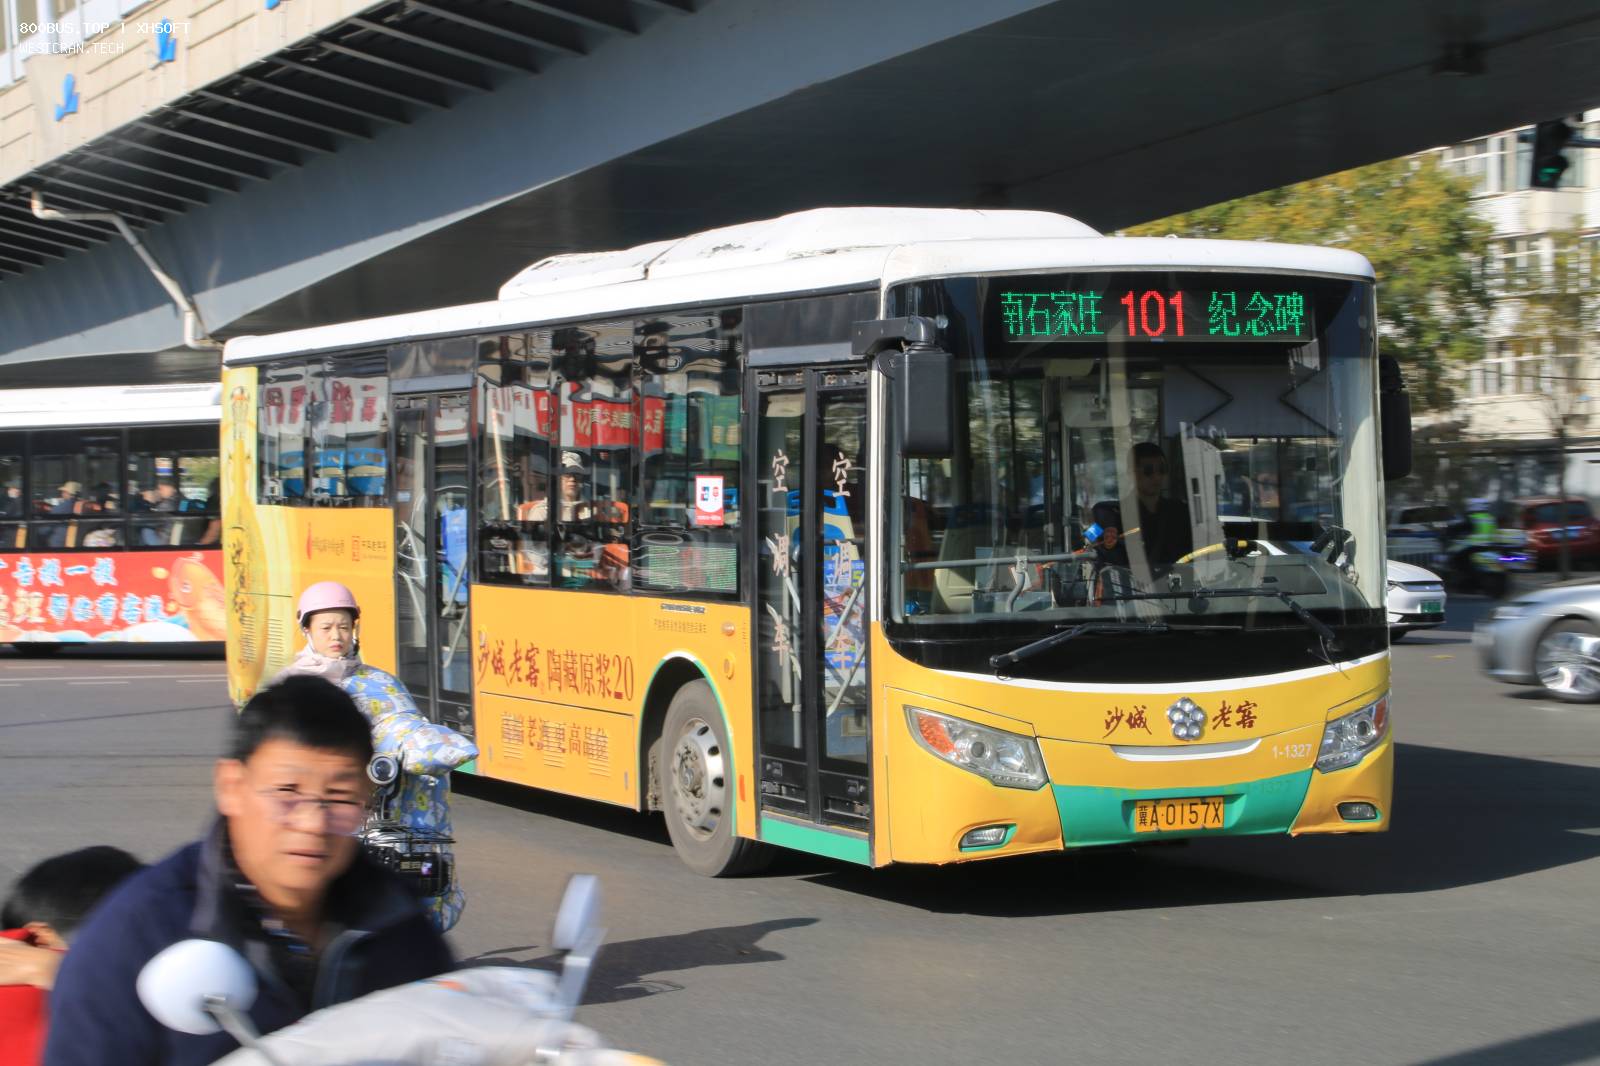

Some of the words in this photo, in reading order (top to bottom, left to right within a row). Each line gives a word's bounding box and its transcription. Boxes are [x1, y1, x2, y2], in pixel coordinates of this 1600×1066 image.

[1120, 290, 1184, 337] 101
[1207, 291, 1305, 337] 纪念碑
[771, 448, 789, 667] 空调车
[832, 451, 852, 669] 空调车
[1212, 700, 1258, 730] 老窖
[1271, 743, 1312, 759] 1-1327
